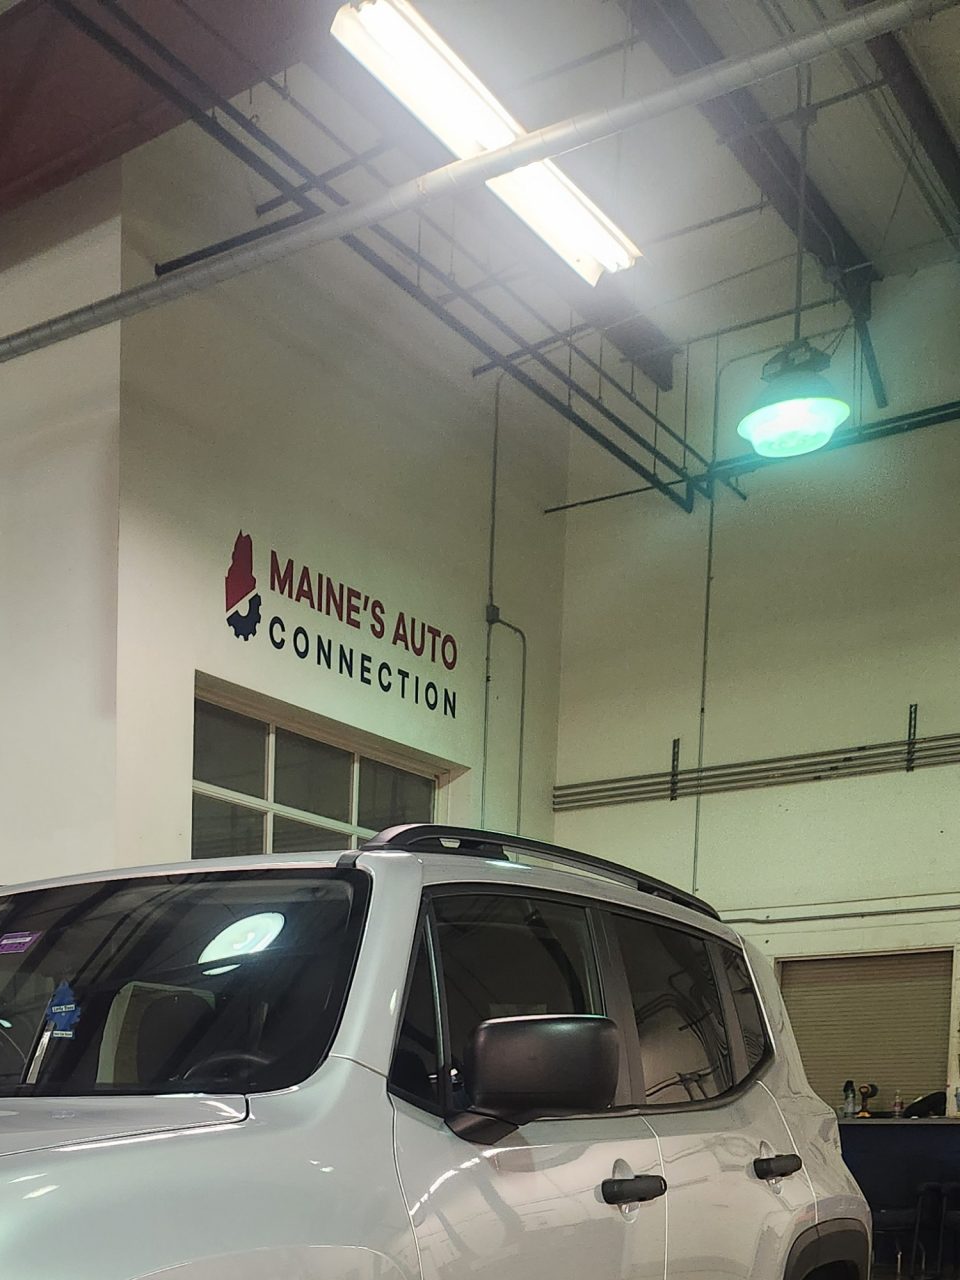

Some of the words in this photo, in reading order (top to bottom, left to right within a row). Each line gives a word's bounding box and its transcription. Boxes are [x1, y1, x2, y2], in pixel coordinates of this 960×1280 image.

[270, 549, 385, 639] MAINE'S
[392, 612, 458, 670] AUTO
[269, 616, 456, 719] CONNECTION
